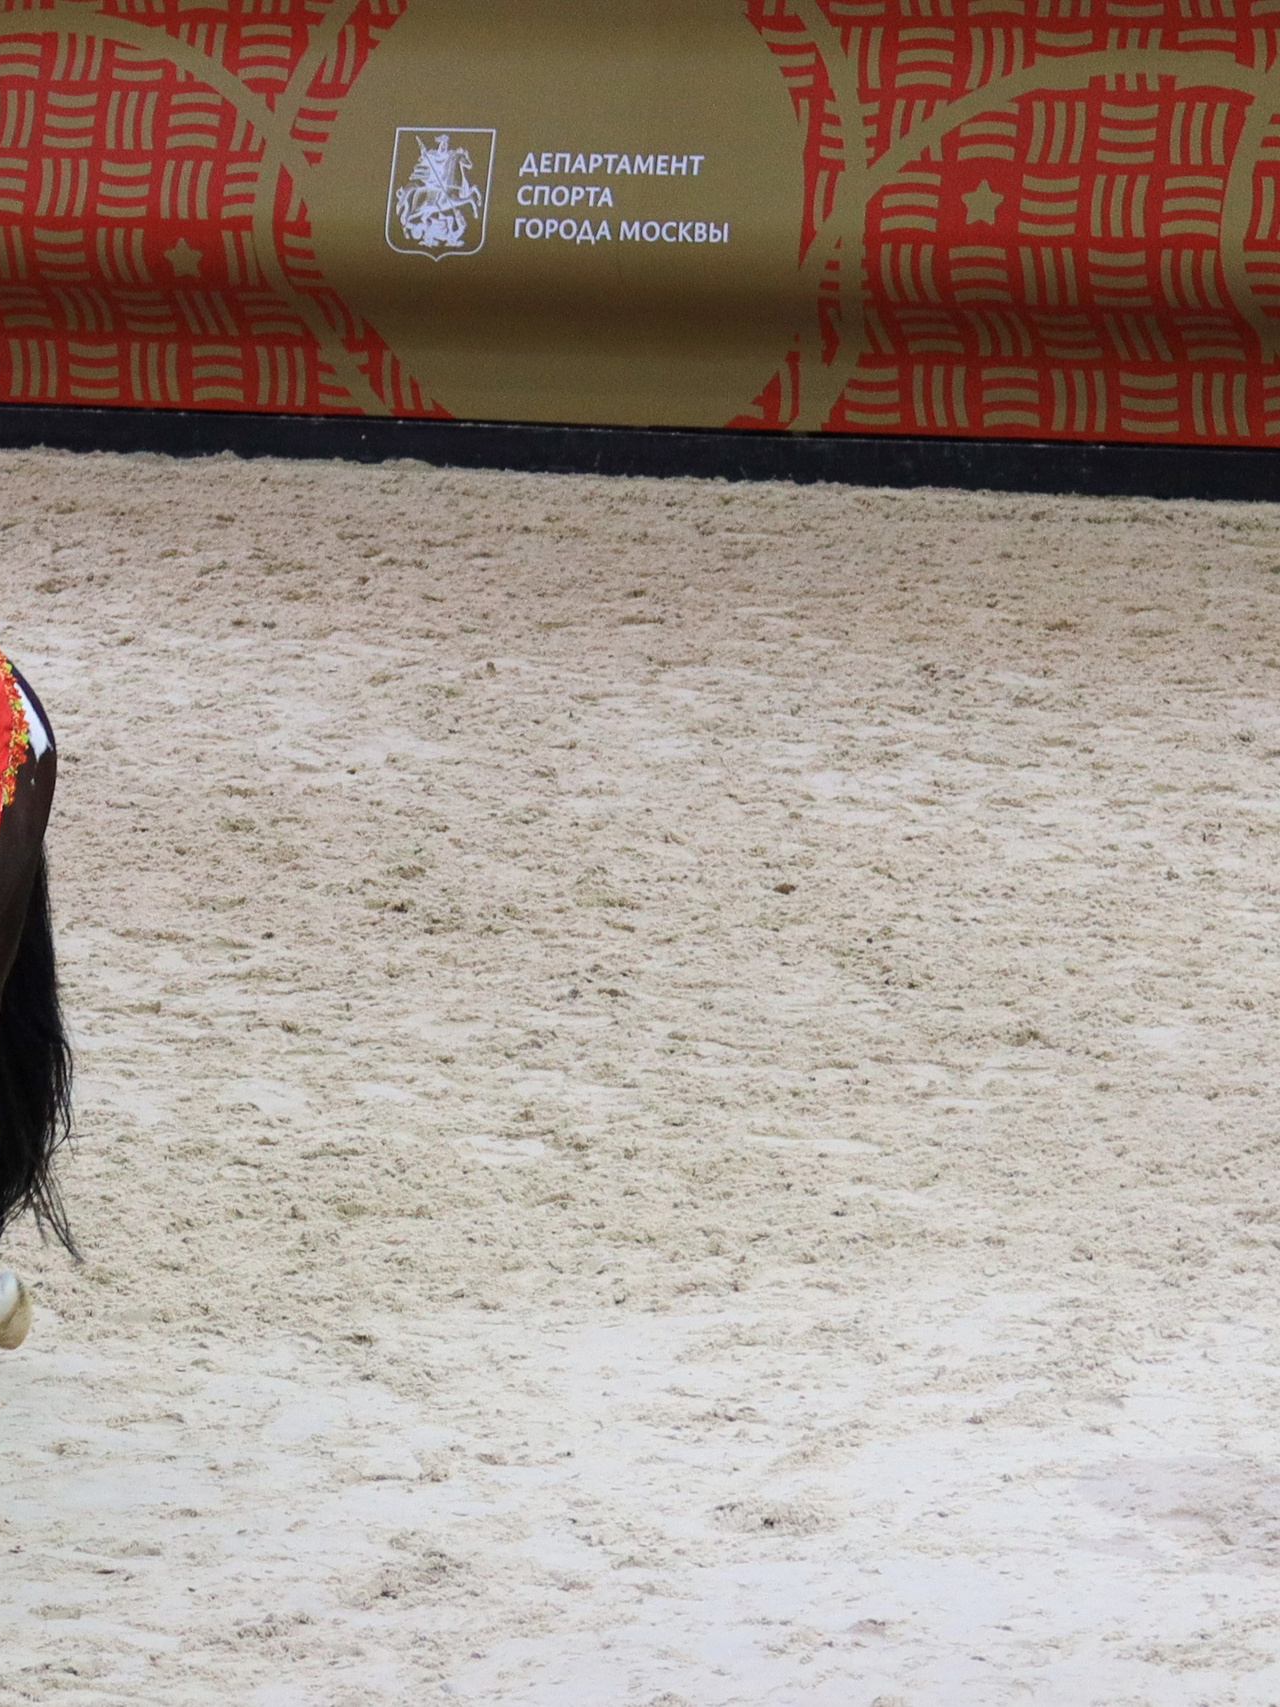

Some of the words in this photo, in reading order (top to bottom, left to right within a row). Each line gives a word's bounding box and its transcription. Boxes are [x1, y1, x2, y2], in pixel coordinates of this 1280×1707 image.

[518, 152, 704, 177] ДЕПАРТАМЕНТ
[516, 185, 614, 208] СПОРТА
[513, 217, 612, 245] ГОРОДА
[618, 220, 730, 243] МОСКВЫ
